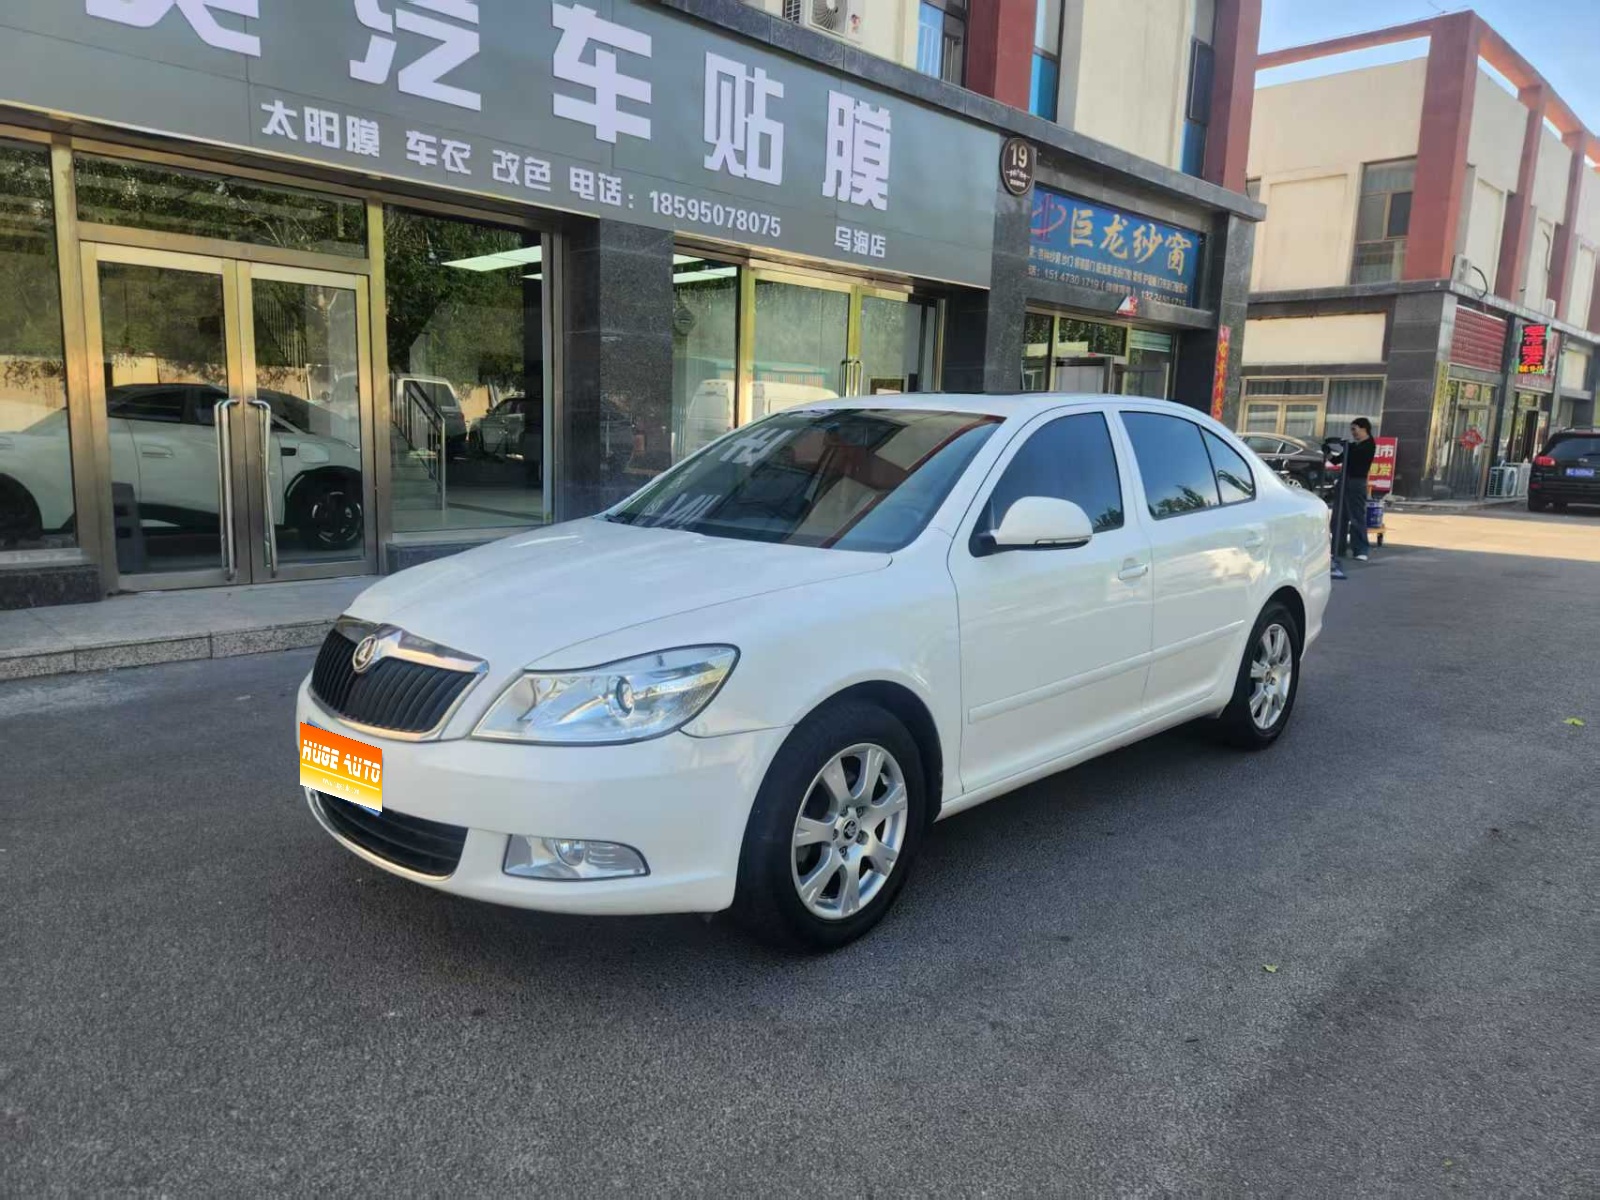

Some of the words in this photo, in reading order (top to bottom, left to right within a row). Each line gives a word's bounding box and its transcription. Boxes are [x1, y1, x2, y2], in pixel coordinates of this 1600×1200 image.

[261, 99, 380, 158] 太阳膜
[406, 130, 472, 175] 车衣
[492, 150, 551, 192] 改色
[1010, 143, 1028, 168] 19
[834, 225, 886, 259] 乌海店
[1070, 207, 1193, 276] 巨龙纱窗
